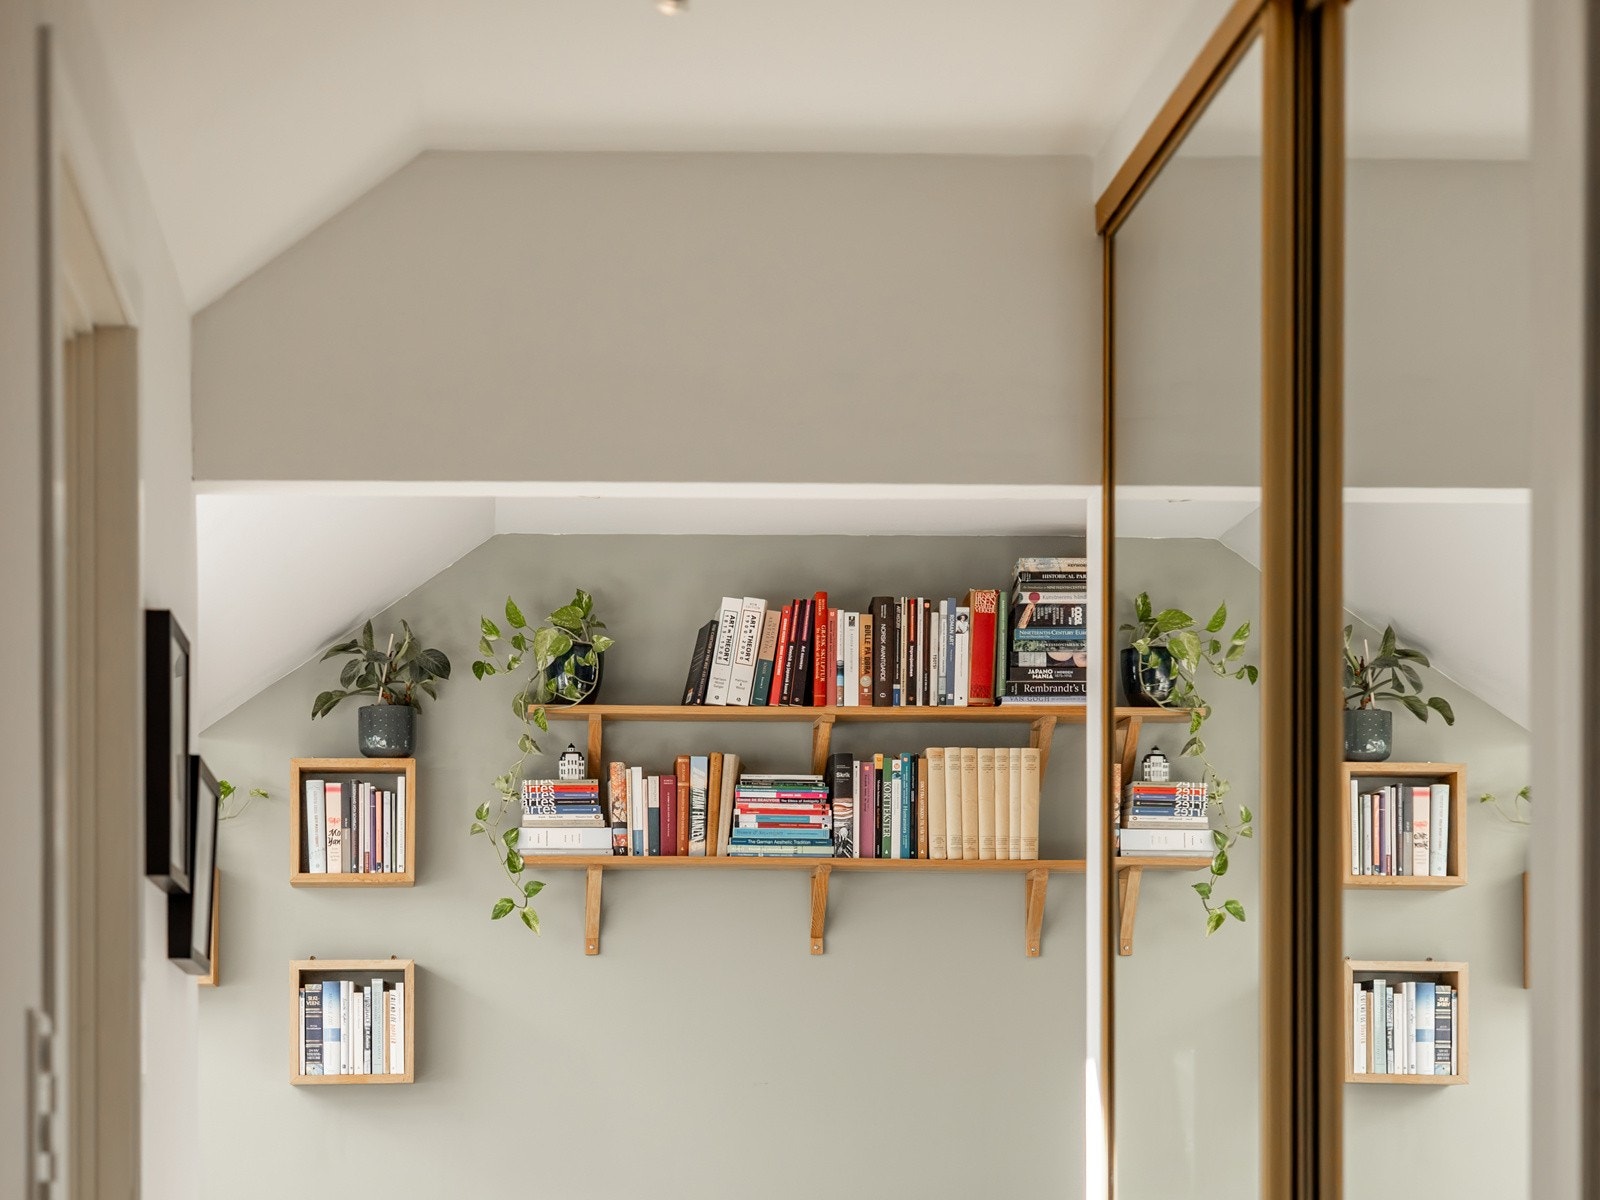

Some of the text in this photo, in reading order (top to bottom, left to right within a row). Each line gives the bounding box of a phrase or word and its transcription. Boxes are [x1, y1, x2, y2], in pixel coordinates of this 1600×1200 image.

[729, 615, 737, 628] ART
[864, 624, 872, 645] BØLLE
[723, 635, 732, 662] THEORY
[744, 635, 754, 662] THEORY
[1024, 684, 1079, 693] Rembrandt's
[523, 785, 555, 793] artes
[525, 806, 557, 814] artes
[882, 781, 891, 838] KORTTEKSTER
[691, 811, 705, 842] FRANZEN
